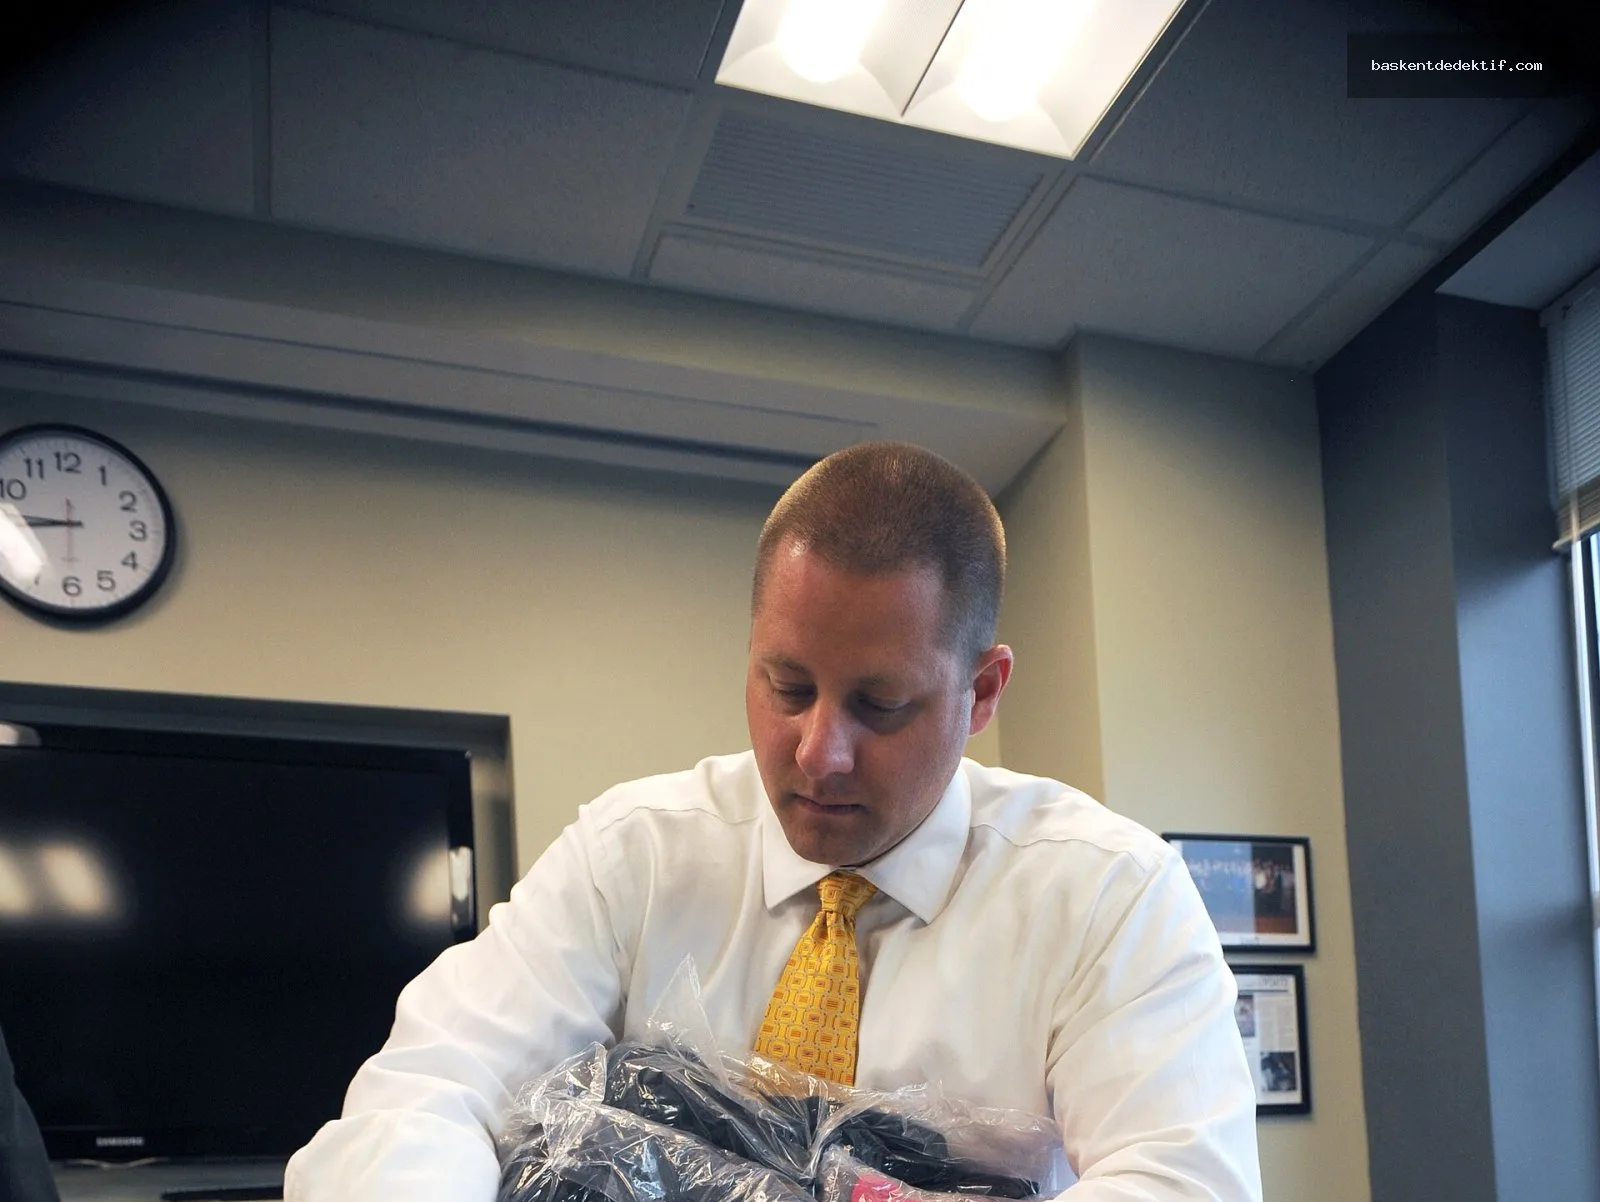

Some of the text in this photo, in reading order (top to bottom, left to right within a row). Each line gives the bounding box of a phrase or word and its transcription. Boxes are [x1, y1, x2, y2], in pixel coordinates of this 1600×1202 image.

[24, 458, 45, 480] 11
[54, 451, 82, 474] 12
[98, 465, 108, 486] 1
[0, 478, 26, 500] 10
[119, 490, 137, 513] 2
[129, 520, 147, 542] 3
[121, 551, 138, 570] 4
[62, 576, 82, 597] 6
[96, 570, 116, 591] 5
